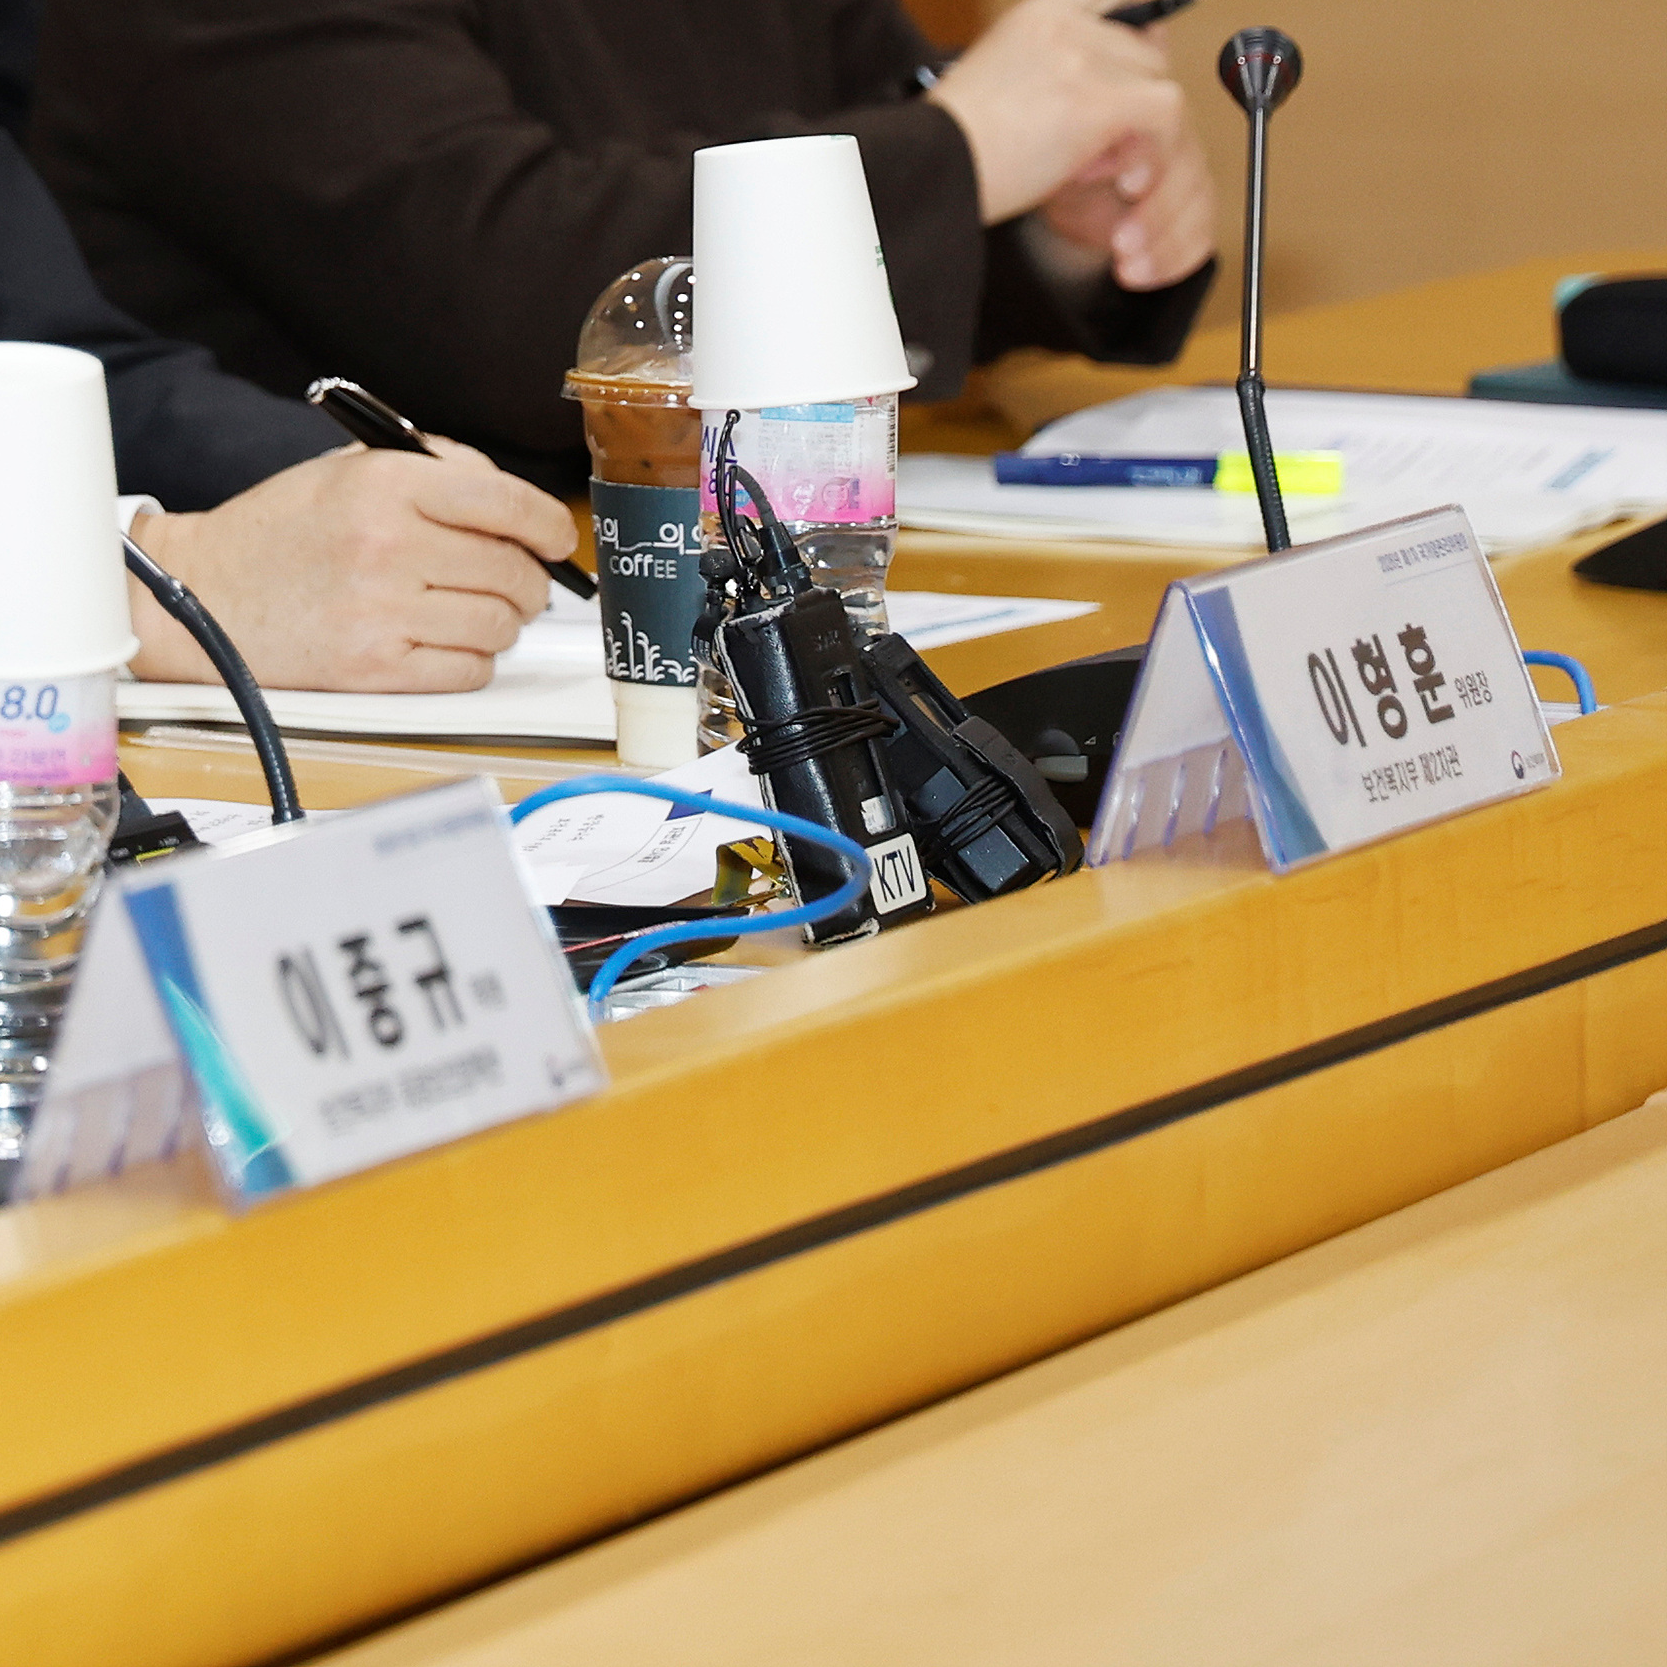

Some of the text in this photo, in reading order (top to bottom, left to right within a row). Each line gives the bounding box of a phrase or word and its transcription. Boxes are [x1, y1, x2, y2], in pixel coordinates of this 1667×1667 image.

[0, 684, 59, 720] 8.0
[1307, 622, 1493, 748] 이형훈 위원장
[1361, 758, 1419, 803] 보건복지부
[873, 846, 915, 904] KTV
[274, 912, 466, 1061] 이중규
